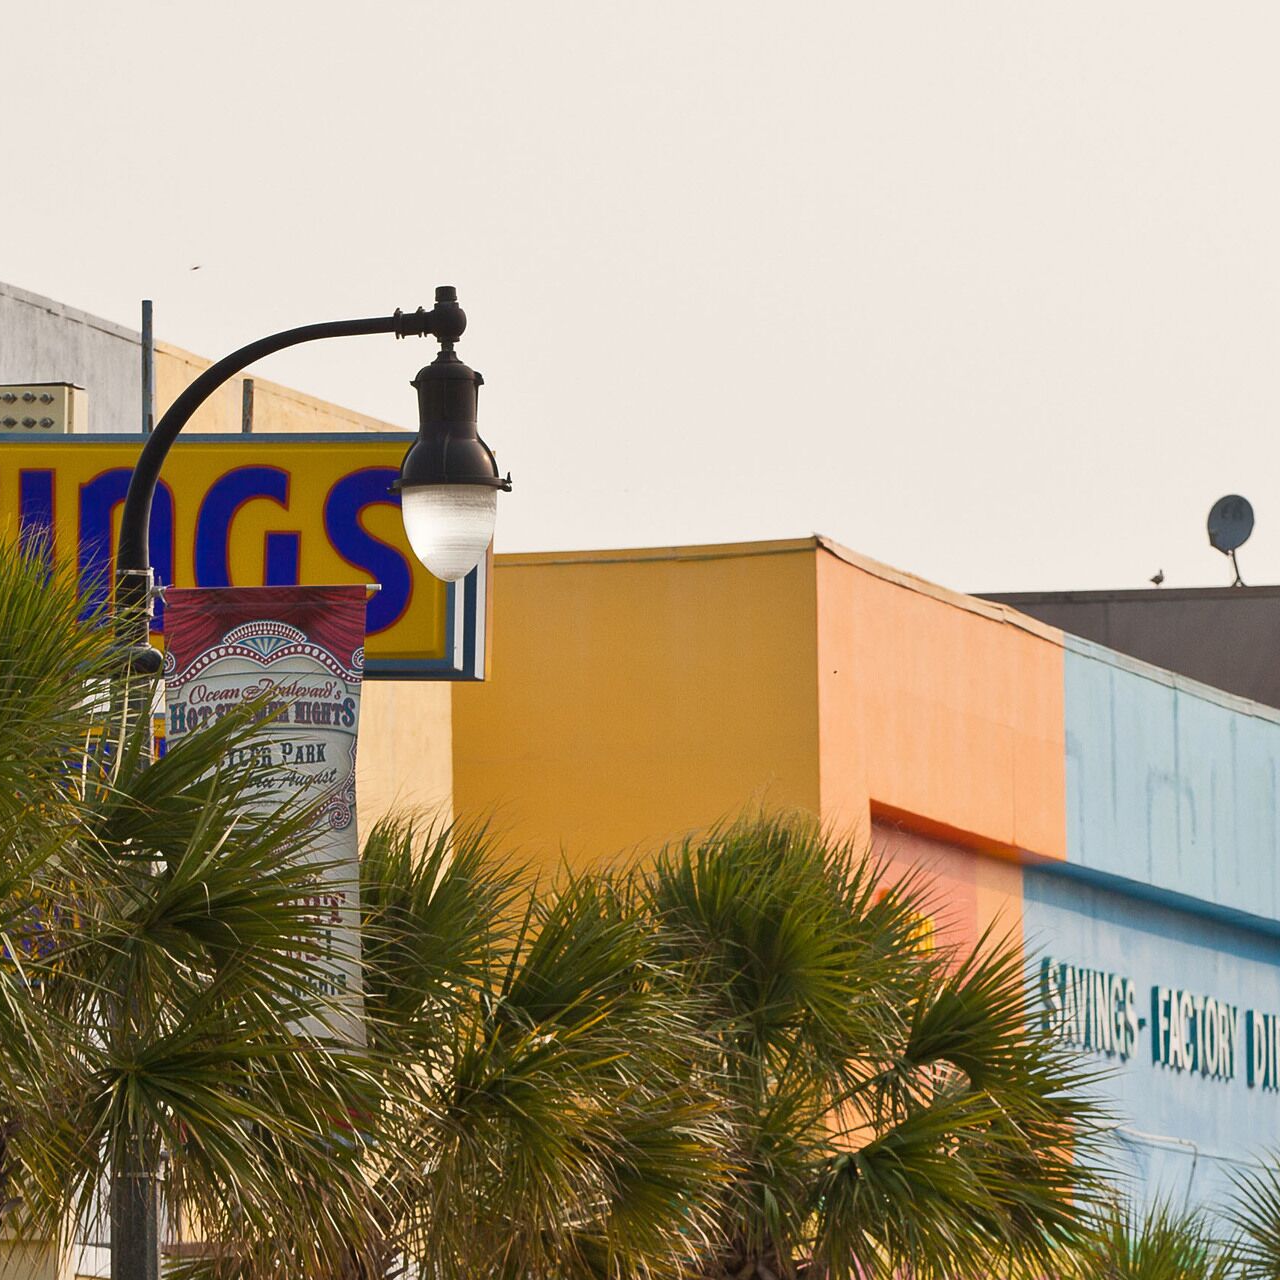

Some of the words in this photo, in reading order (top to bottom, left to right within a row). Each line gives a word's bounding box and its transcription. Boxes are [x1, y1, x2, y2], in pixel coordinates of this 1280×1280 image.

[189, 684, 240, 705] Ocean
[169, 702, 212, 735] HOT
[215, 700, 289, 728] SMER
[294, 697, 356, 728] NIGHTS
[280, 742, 327, 764] PARK
[279, 768, 337, 791] August
[1151, 985, 1241, 1083] FACTORY
